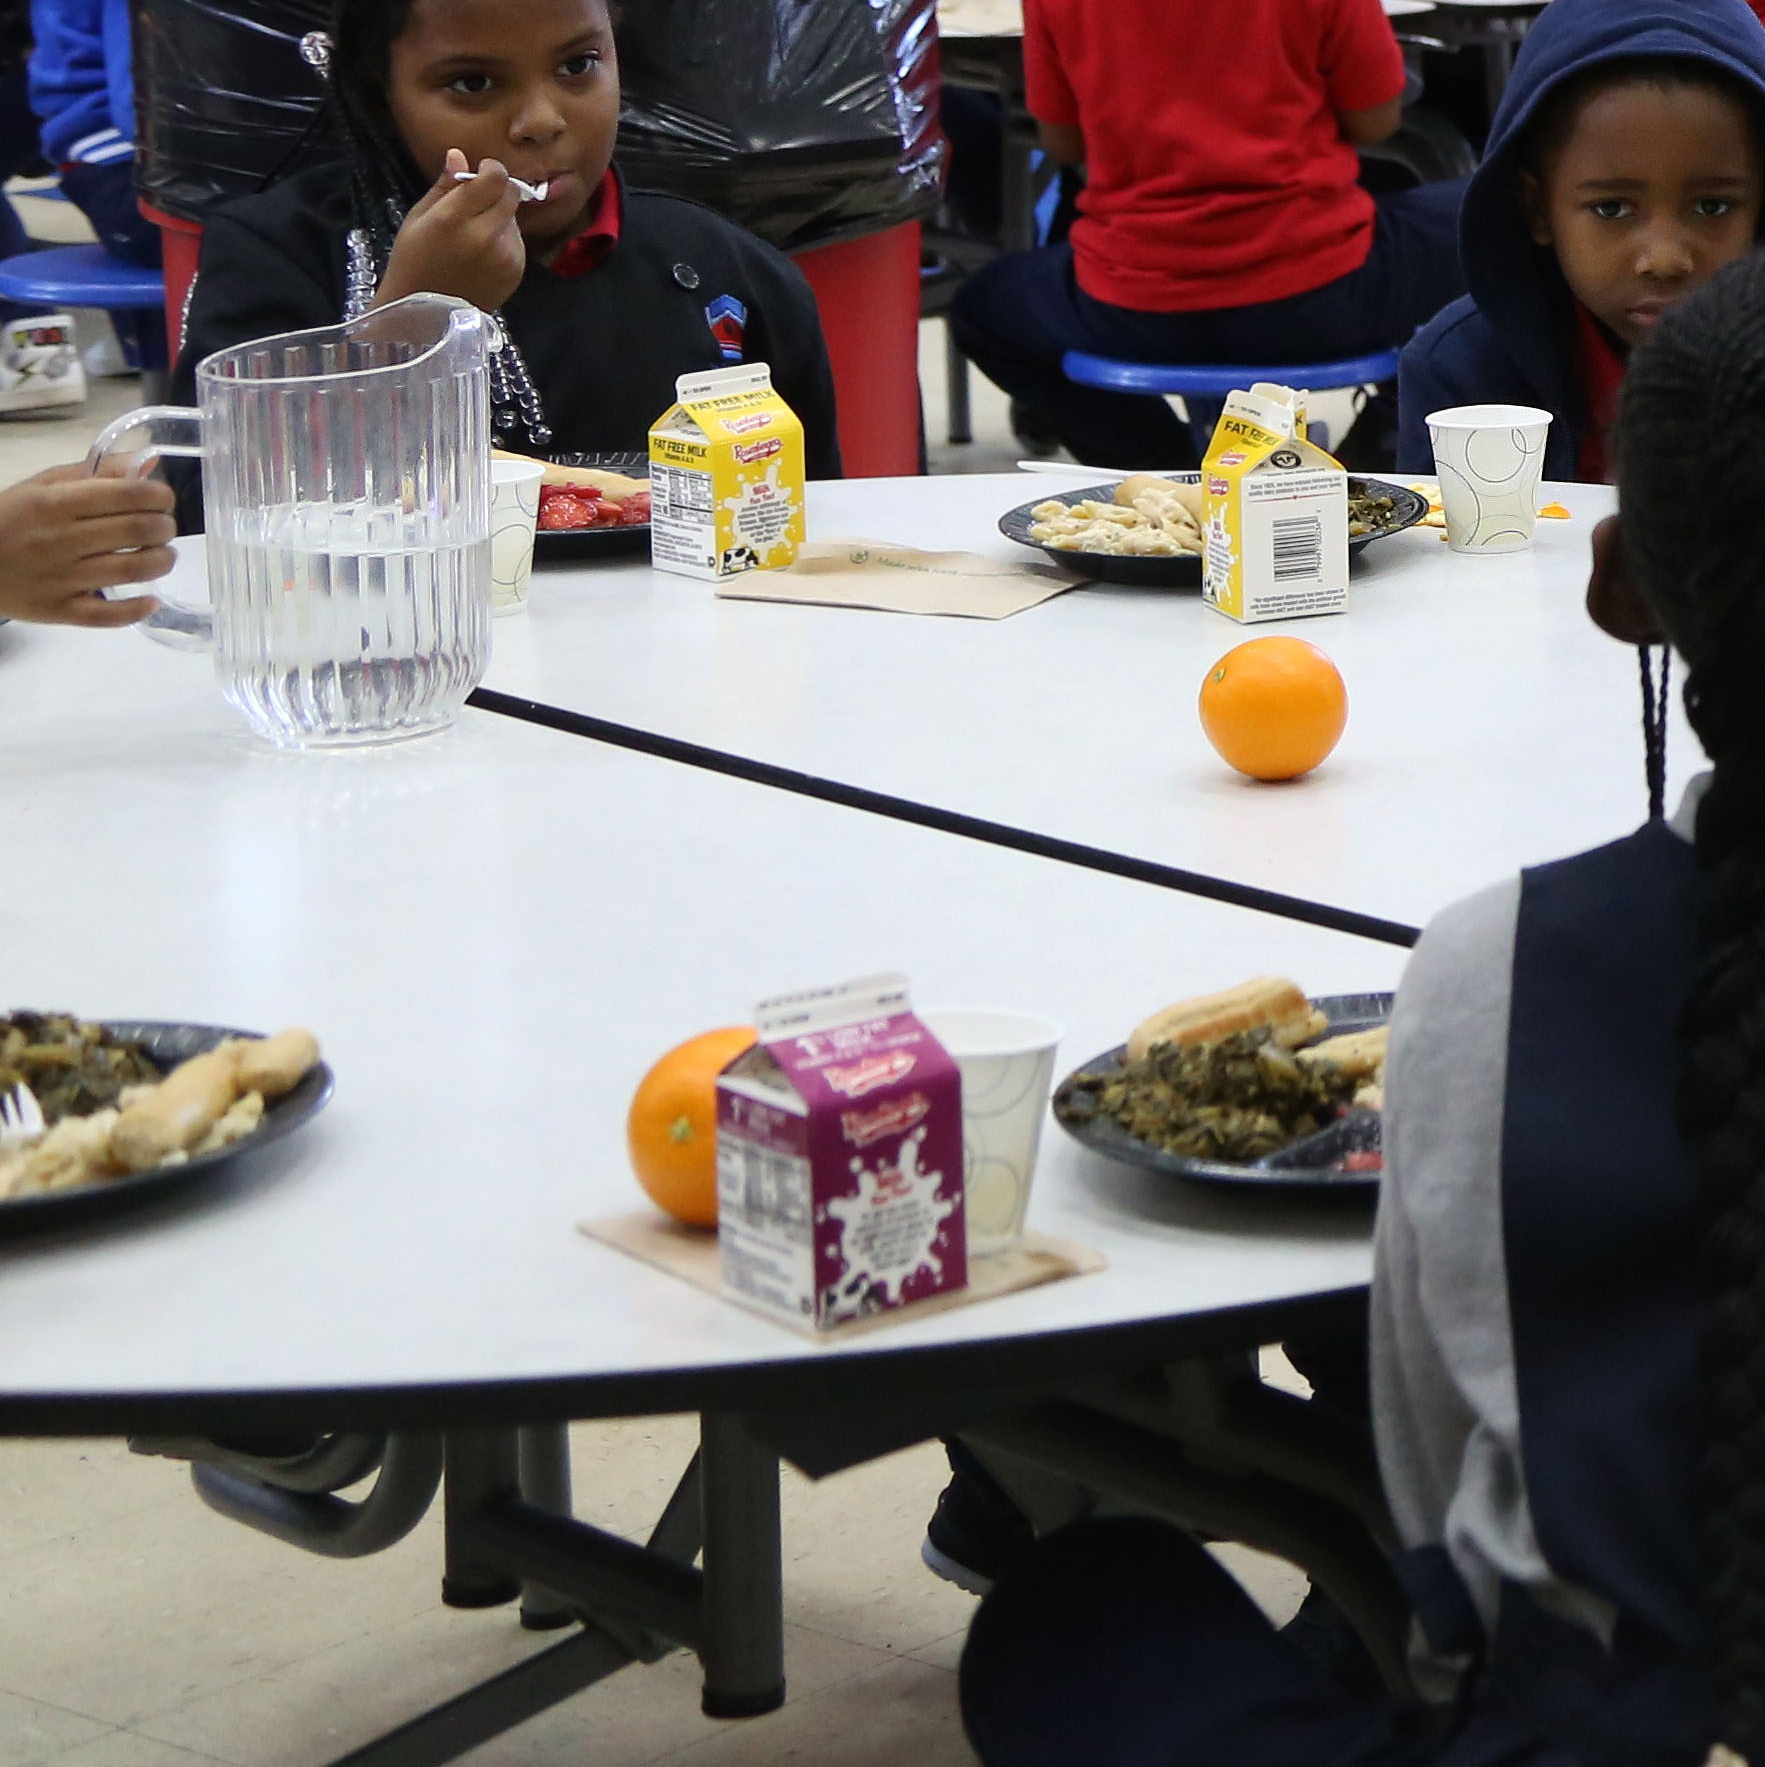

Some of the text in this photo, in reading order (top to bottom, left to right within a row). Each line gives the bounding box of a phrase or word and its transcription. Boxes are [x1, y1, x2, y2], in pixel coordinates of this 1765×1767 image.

[690, 390, 776, 411] FAT FREE MILK
[1224, 420, 1249, 435] FAT
[654, 438, 708, 459] FAT FREE MILK
